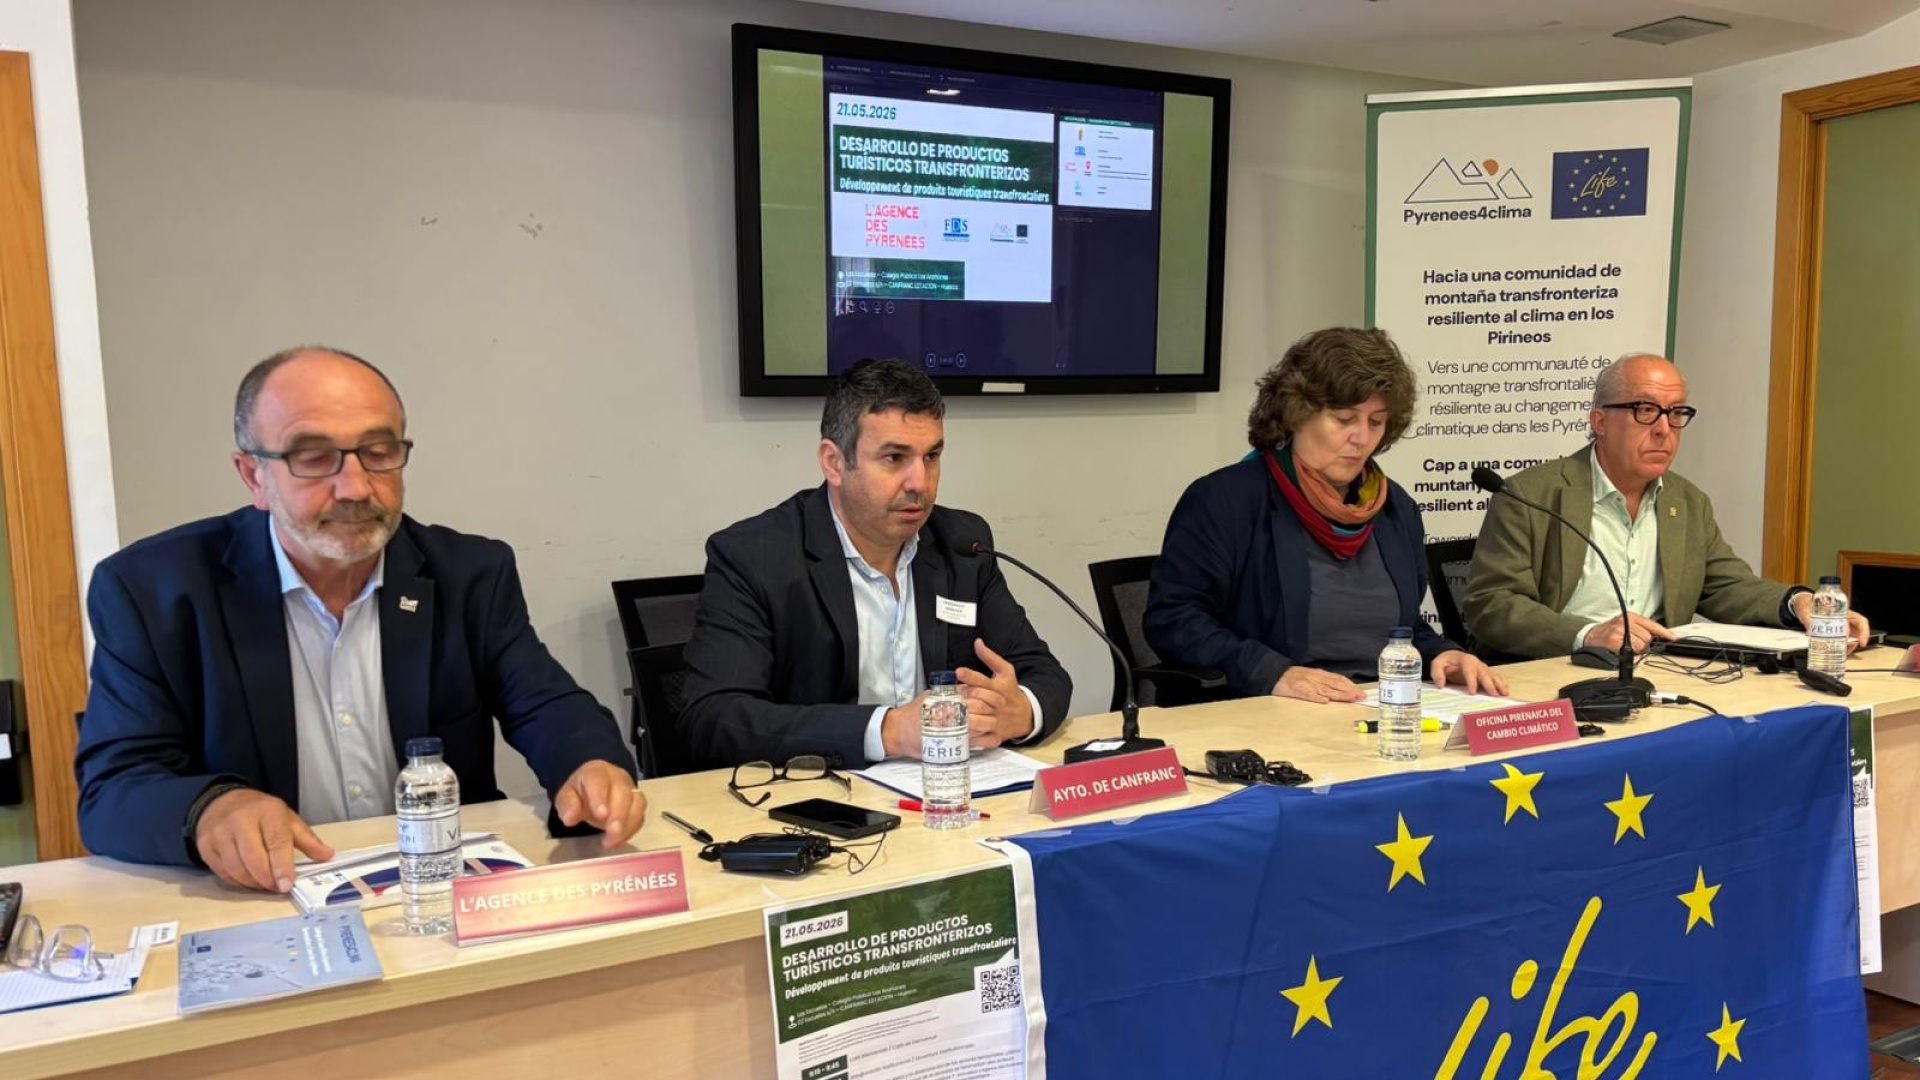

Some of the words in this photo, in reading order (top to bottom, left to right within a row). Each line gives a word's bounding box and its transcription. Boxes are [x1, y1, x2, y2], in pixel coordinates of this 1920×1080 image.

[837, 102, 897, 120] 21.05.2026
[839, 136, 918, 157] DESARROLLO
[920, 143, 936, 158] DE
[937, 144, 1009, 163] PRODUCTOS
[840, 153, 912, 174] TURÍSTICOS
[914, 160, 1030, 182] TRANSFRONTERIZOS
[902, 183, 912, 194] de
[913, 184, 946, 196] produits
[1580, 166, 1618, 198] Life
[865, 220, 888, 232] DES
[944, 217, 969, 233] FDS
[1403, 206, 1532, 225] Pyrenees4clima
[1423, 269, 1468, 284] Hacia
[1471, 270, 1501, 283] una
[1504, 264, 1597, 282] comunidad
[1600, 263, 1622, 278] de
[1425, 289, 1496, 306] montaña
[1499, 285, 1618, 303] transfronteriza
[1427, 310, 1500, 326] resiliente
[1503, 308, 1517, 323] al
[1520, 308, 1564, 323] clima
[1567, 310, 1588, 321] en
[1591, 306, 1614, 321] los
[1488, 330, 1552, 345] Pirineos
[1427, 361, 1459, 375] Vers
[1462, 363, 1489, 374] une
[1492, 356, 1588, 372] communauté
[1591, 354, 1612, 369] de
[1427, 381, 1500, 398] montagne
[1503, 376, 1597, 393] transfrontaliè
[1429, 401, 1492, 416] résiliente
[1494, 402, 1512, 414] au
[1515, 399, 1591, 416] changeme
[1416, 421, 1489, 438] climatique
[1492, 420, 1527, 435] dans
[1529, 419, 1549, 434] les
[1423, 458, 1455, 475] Cap
[1458, 461, 1468, 470] a
[1471, 460, 1500, 470] una
[1417, 498, 1473, 512] esilient
[1476, 714, 1508, 728] OFICINA
[1509, 709, 1548, 723] PIRENAICA
[1549, 706, 1563, 718] DEL
[1486, 728, 1518, 741] CAMBIO
[1518, 722, 1559, 737] CLIMÁTICO
[1053, 784, 1091, 803] AYTO.
[1094, 780, 1110, 795] DE
[1113, 766, 1178, 790] CANFRANC
[553, 884, 586, 900] DES
[591, 870, 678, 897] PYRÉNÉES
[785, 916, 844, 940] 21.05.2026
[782, 936, 869, 969] DESARROLLO
[870, 932, 888, 947] DE
[890, 914, 969, 942] PRODUCTOS
[782, 954, 862, 984] TURÍSTICOS
[864, 922, 993, 962] TRANSFRONTERIZOS
[785, 973, 850, 1000] Développement
[850, 969, 862, 981] de
[863, 961, 901, 981] produits
[902, 949, 951, 970] touristiques
[952, 936, 1017, 957] transfrontaliers
